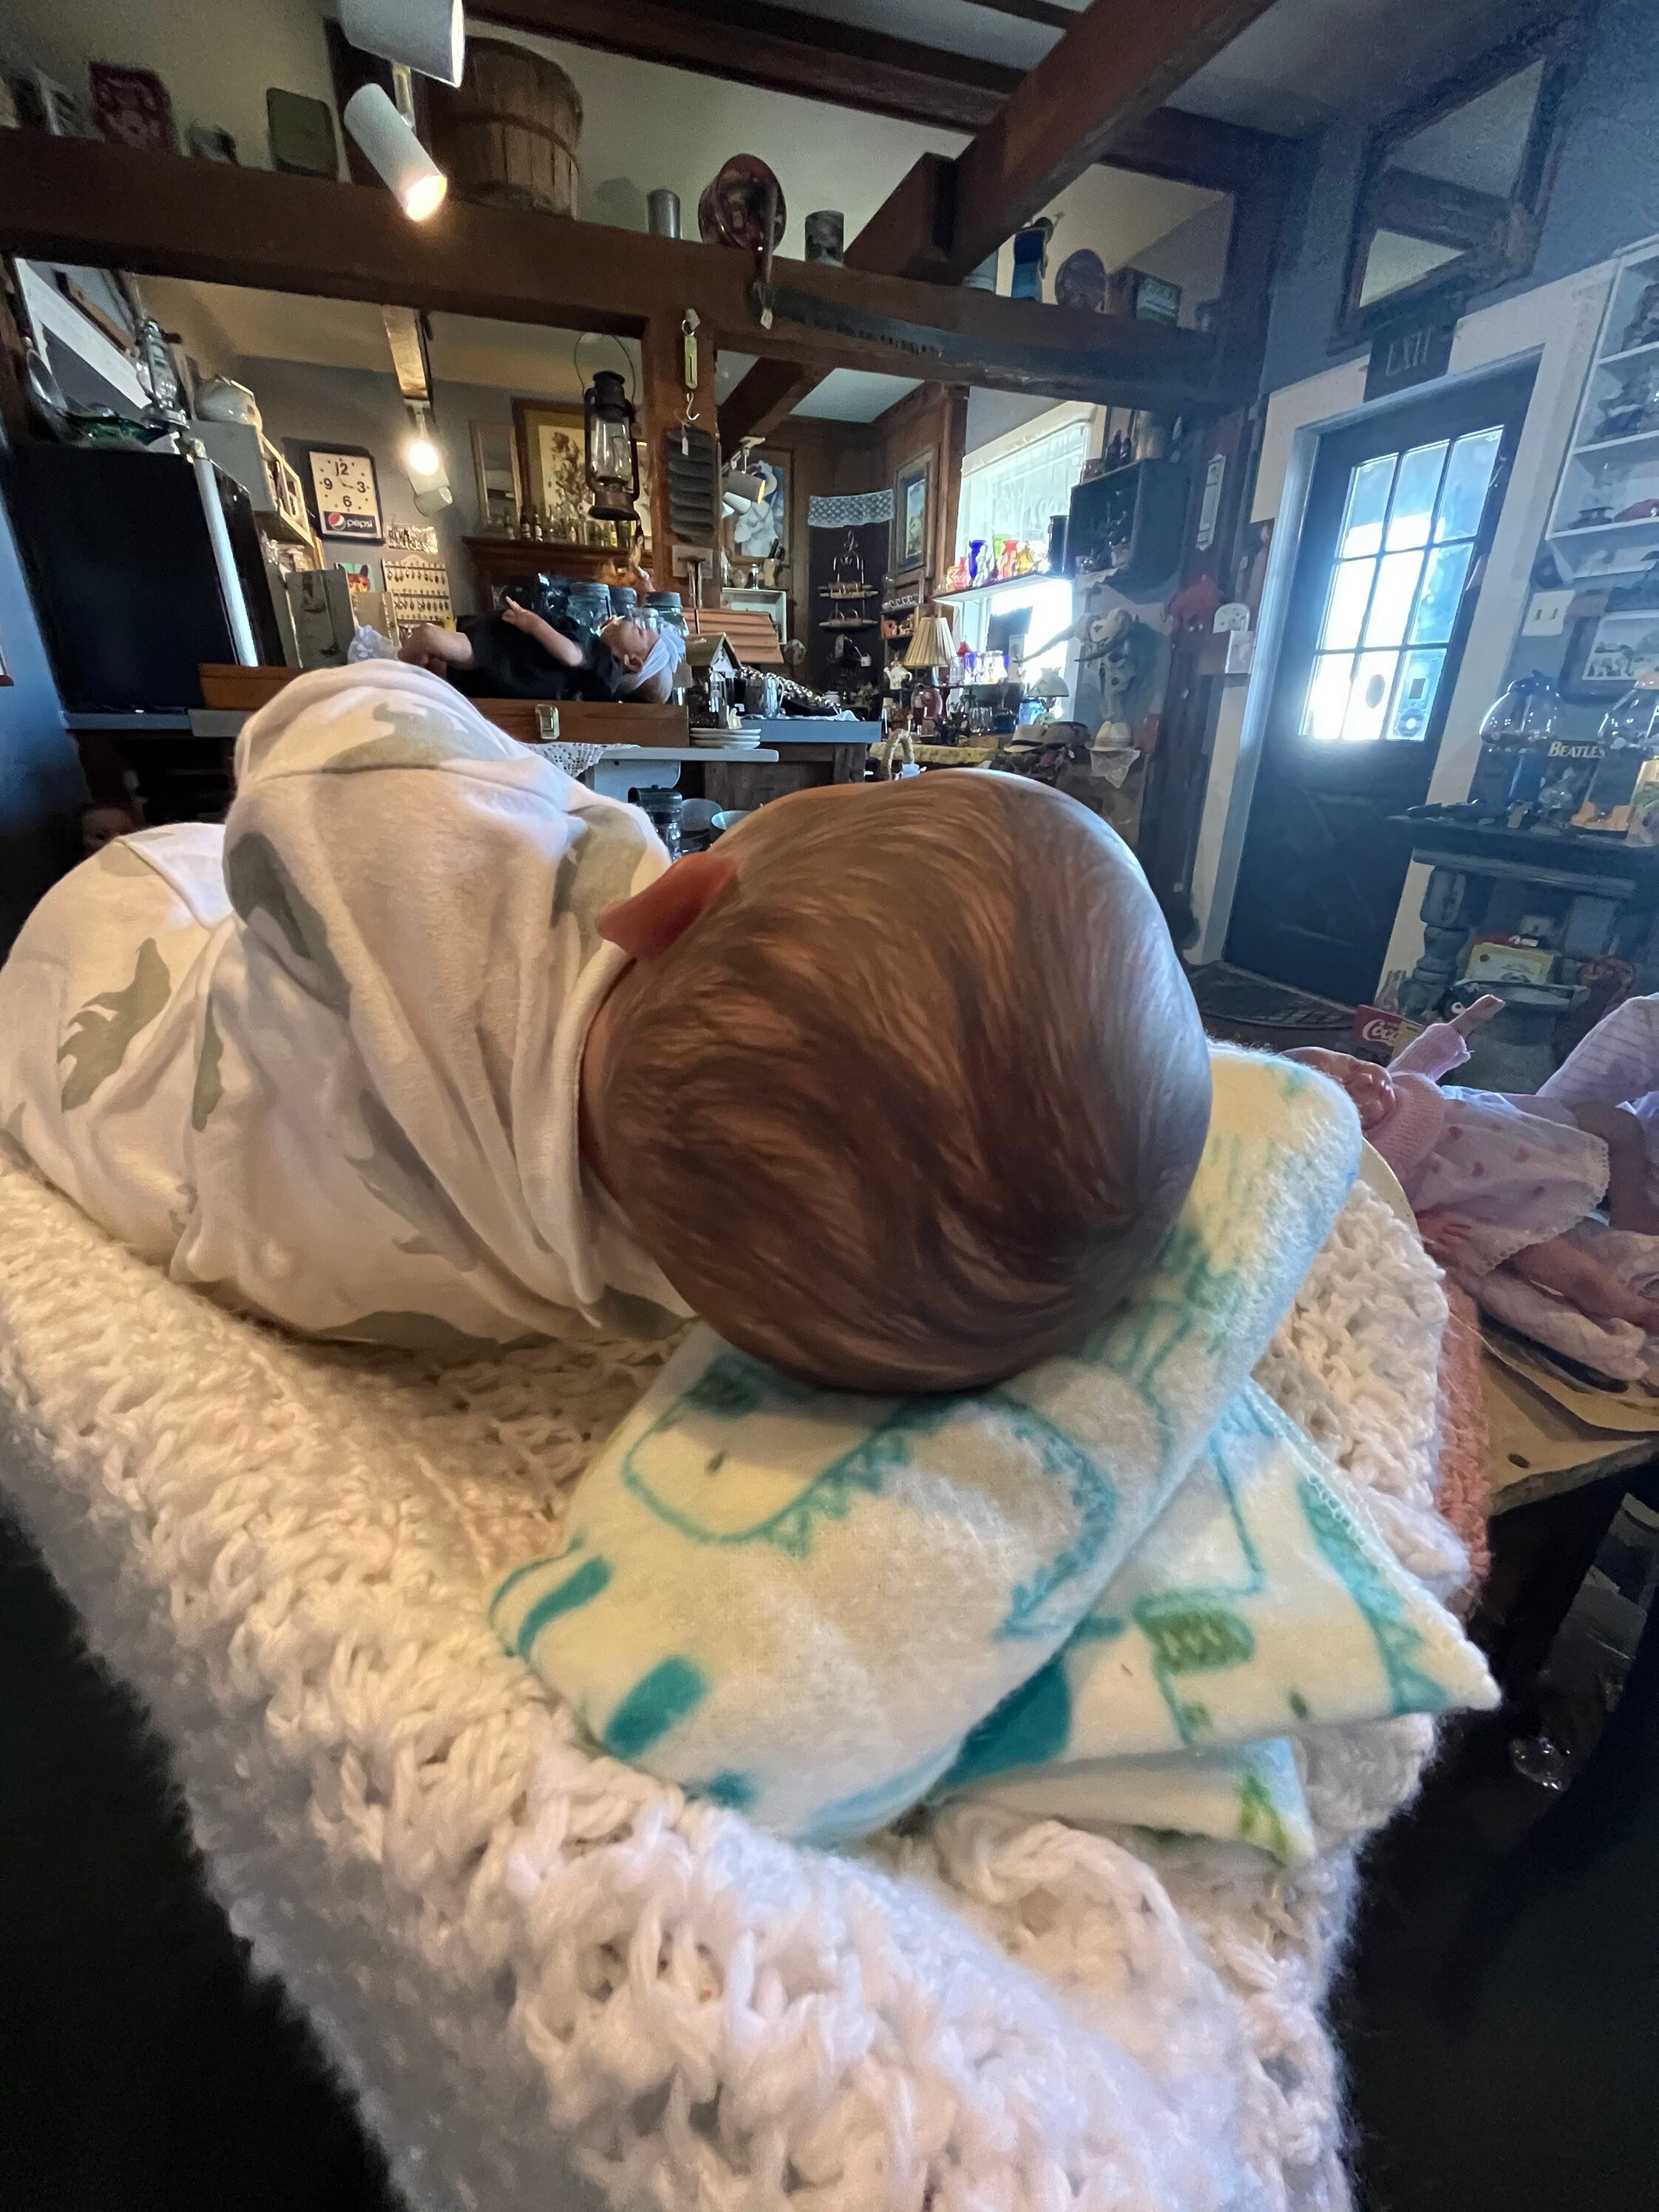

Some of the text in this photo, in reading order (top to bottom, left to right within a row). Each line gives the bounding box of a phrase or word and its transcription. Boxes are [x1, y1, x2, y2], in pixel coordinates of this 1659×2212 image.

[335, 461, 349, 475] 12
[323, 478, 333, 489] 9
[357, 481, 366, 493] 3
[342, 495, 352, 507] 6
[347, 520, 373, 529] pepsi
